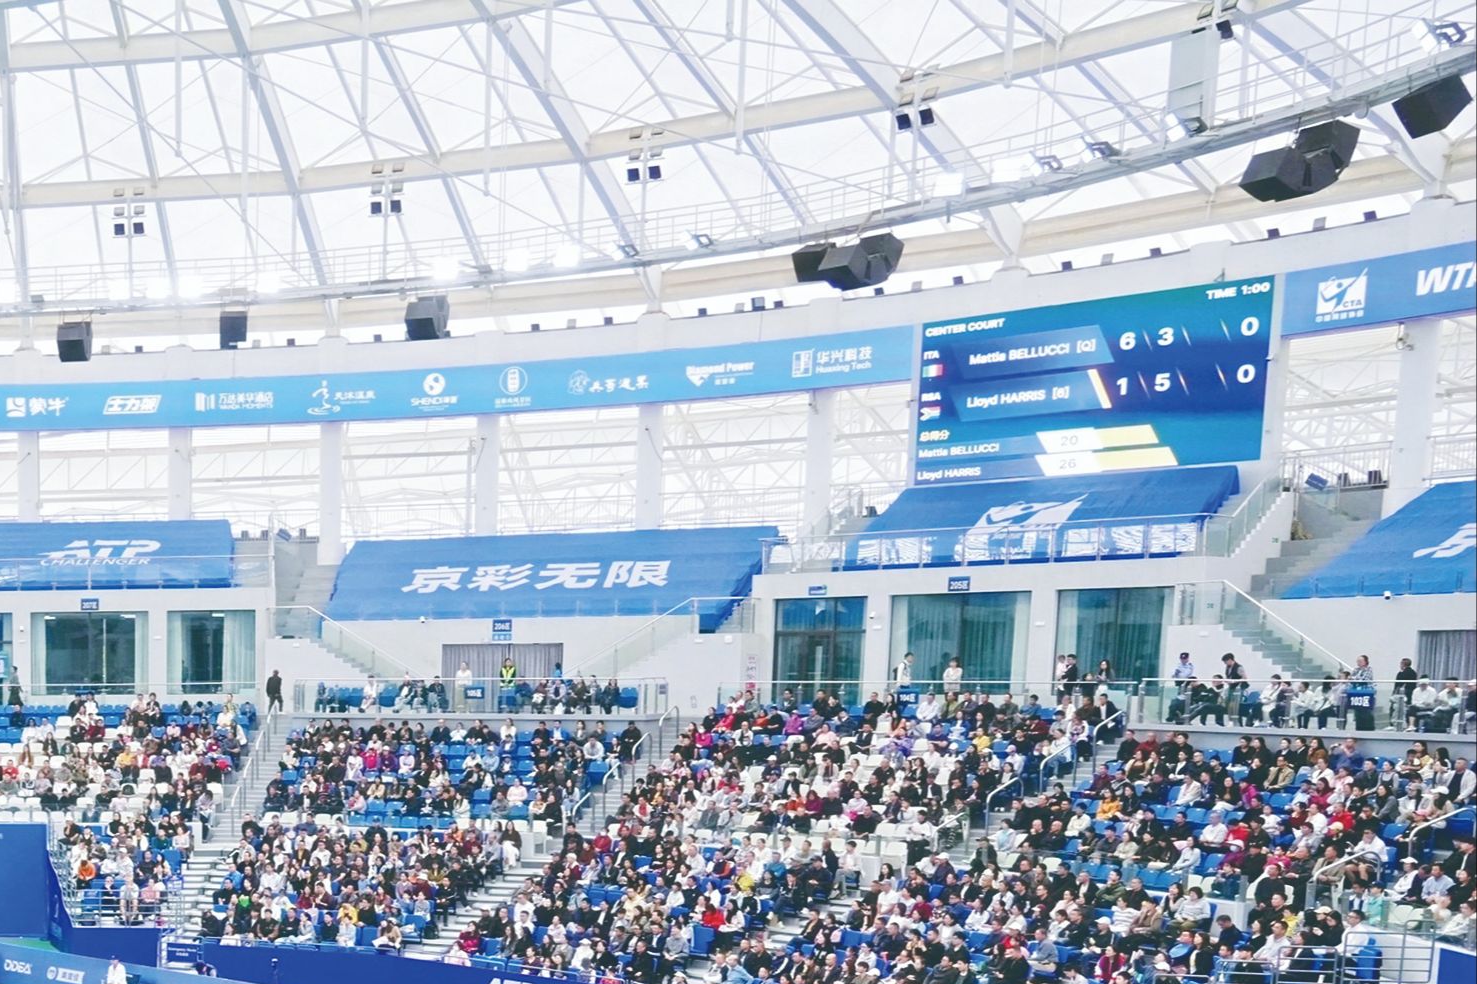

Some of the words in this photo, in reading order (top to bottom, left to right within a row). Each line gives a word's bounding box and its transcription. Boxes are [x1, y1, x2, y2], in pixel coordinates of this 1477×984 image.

[1206, 287, 1237, 300] TIME
[1241, 282, 1271, 296] 1:00
[925, 324, 966, 337] CENTER
[968, 318, 1005, 331] COURT
[1119, 332, 1136, 350] 6
[1157, 327, 1174, 346] 3
[1240, 317, 1259, 336] 0
[923, 351, 939, 360] ITA
[1009, 343, 1070, 360] BELLUCCI
[1116, 378, 1128, 395] 1
[1154, 373, 1171, 391] 5
[1237, 364, 1256, 384] 0
[29, 397, 65, 416] 蒙牛
[967, 395, 997, 409] Lloyd
[1001, 390, 1045, 404] HARRIS
[950, 443, 999, 456] BELLUCCI
[1061, 435, 1078, 447] 20
[917, 469, 943, 481] Lloyd
[945, 467, 981, 478] HARRIS
[1059, 459, 1077, 470] 26
[39, 539, 160, 558] ATP
[41, 557, 151, 566] CHALLENGER
[401, 561, 672, 593] 京彩无限
[4, 959, 32, 975] ODEA
